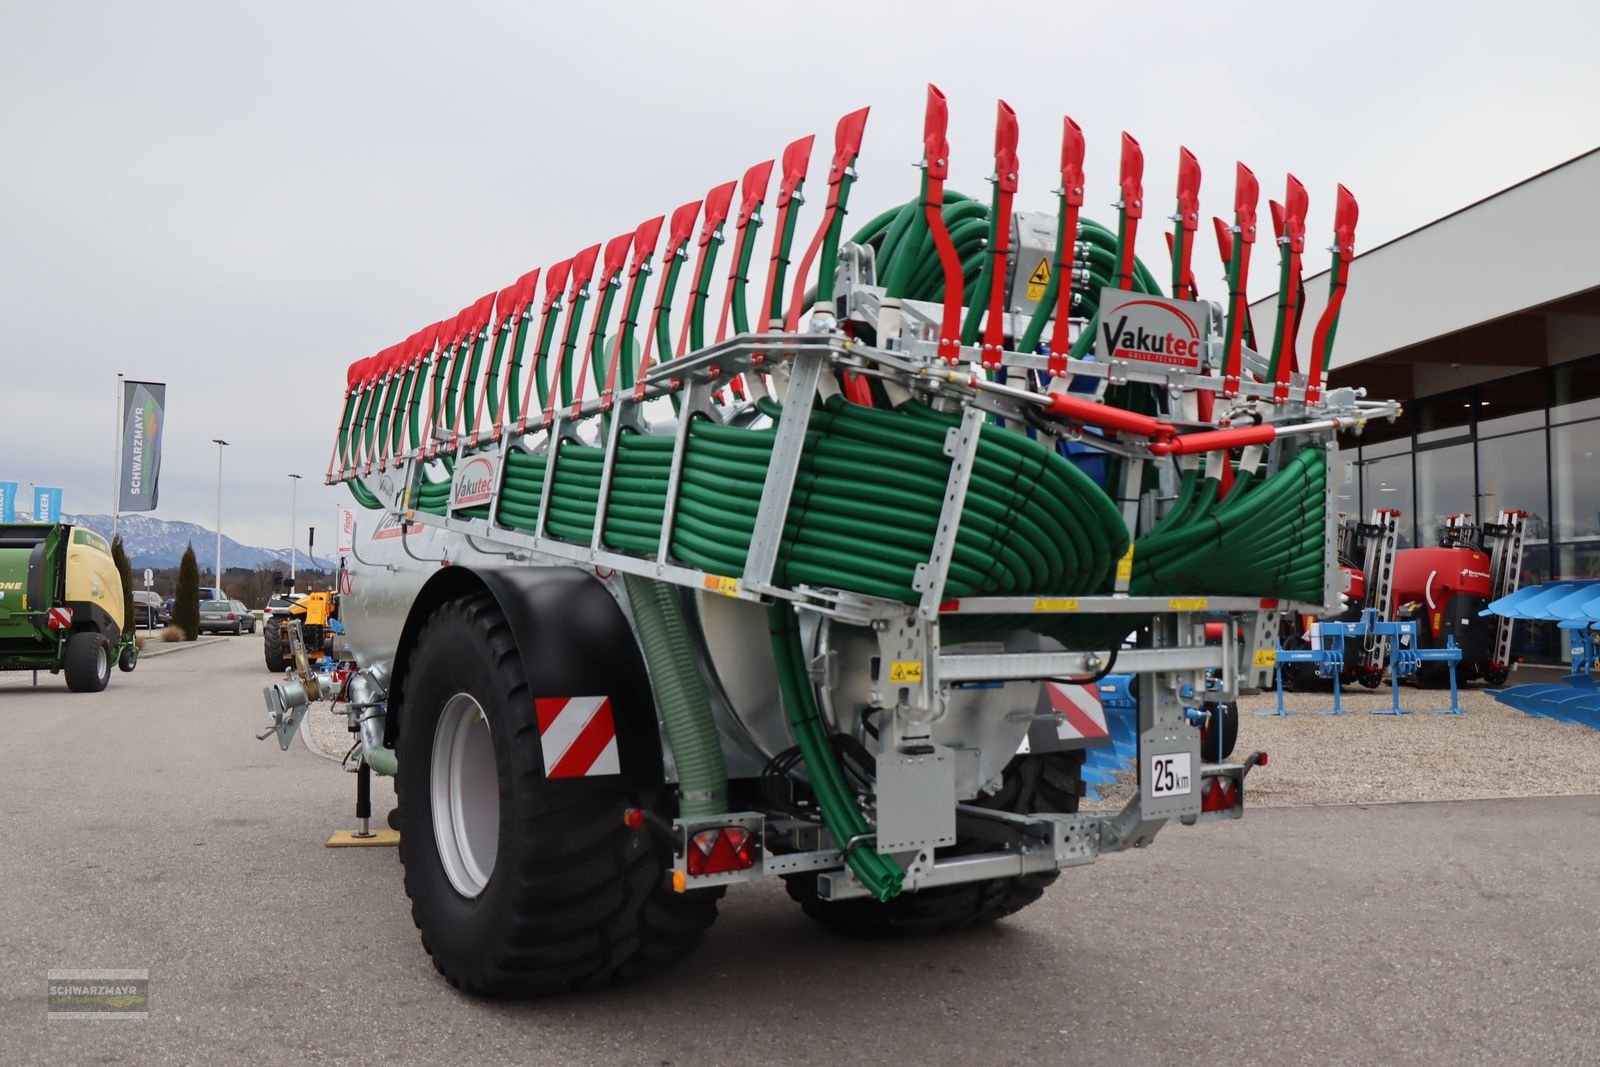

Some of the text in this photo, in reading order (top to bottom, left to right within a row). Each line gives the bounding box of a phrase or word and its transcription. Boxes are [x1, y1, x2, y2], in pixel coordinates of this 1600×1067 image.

[1102, 314, 1200, 359] Vakutec
[130, 407, 145, 495] SCHWARZMAYR
[454, 474, 493, 505] Vakutec
[1154, 758, 1189, 792] 25 km
